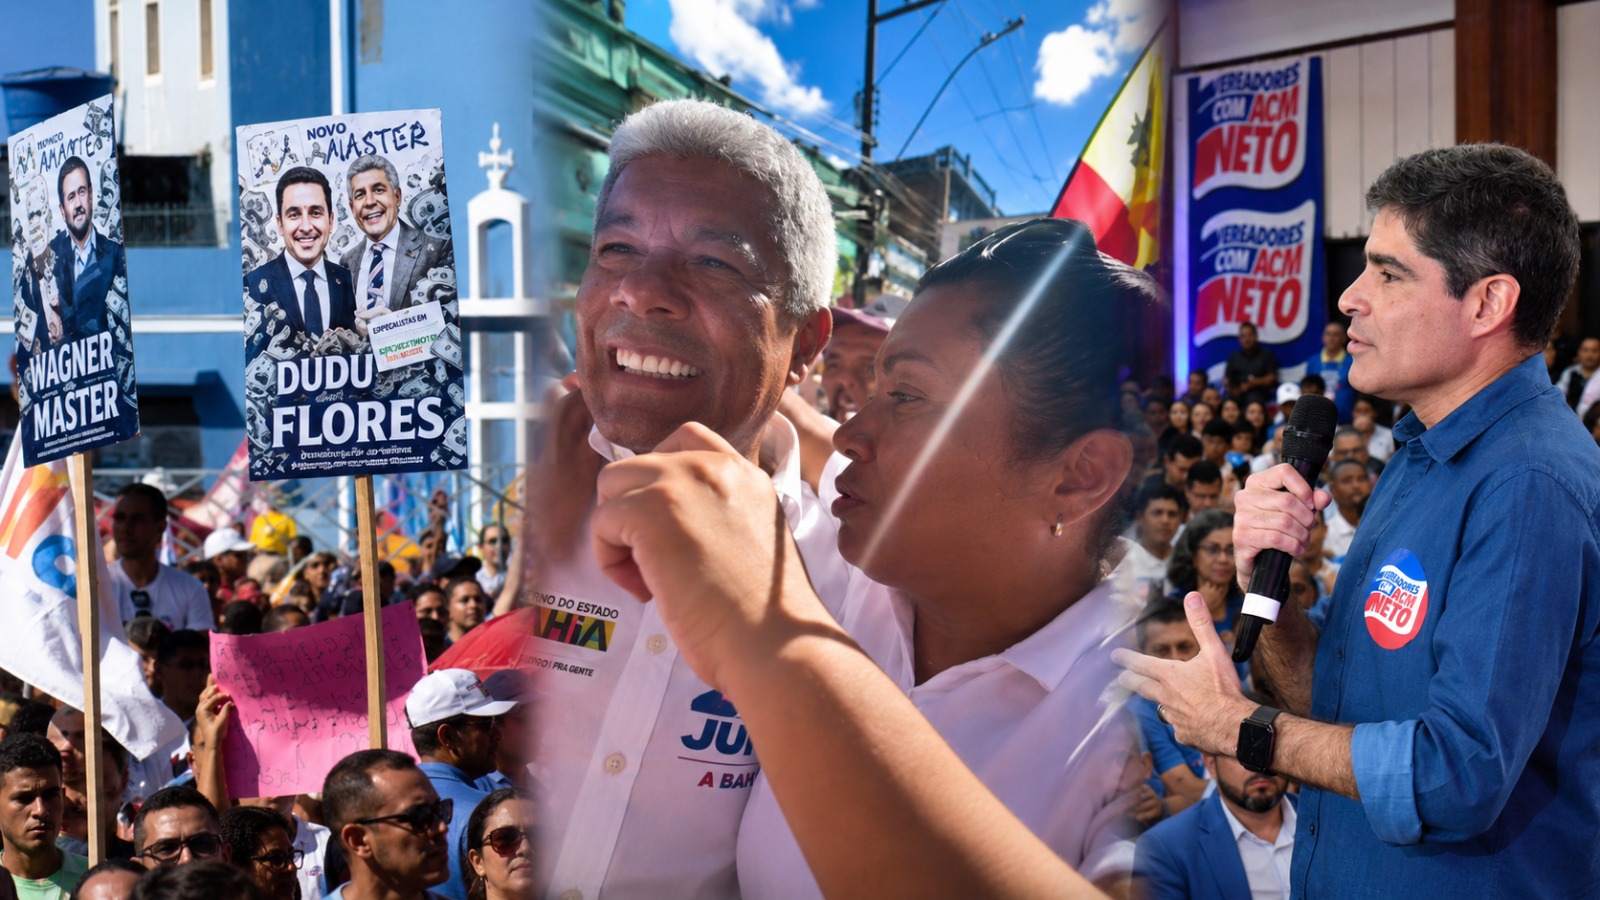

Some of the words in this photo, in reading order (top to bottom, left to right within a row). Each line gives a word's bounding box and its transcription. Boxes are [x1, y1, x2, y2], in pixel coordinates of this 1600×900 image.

[1212, 96, 1246, 122] COM
[1249, 84, 1299, 122] ACM
[306, 122, 347, 141] NOVO
[1194, 119, 1299, 189] NETO
[1215, 248, 1249, 272] COM
[1253, 242, 1304, 278] ACM
[1195, 276, 1303, 336] NETO
[28, 330, 115, 394] WAGNER
[277, 353, 373, 396] DUDU
[33, 379, 120, 441] MASTER
[272, 396, 445, 448] FLORES
[558, 597, 575, 610] DO
[576, 601, 619, 619] ESTADO
[1365, 591, 1412, 628] NETO
[1391, 587, 1418, 609] ACM
[552, 661, 568, 672] PRA
[568, 665, 594, 677] GENTE
[697, 771, 714, 788] A
